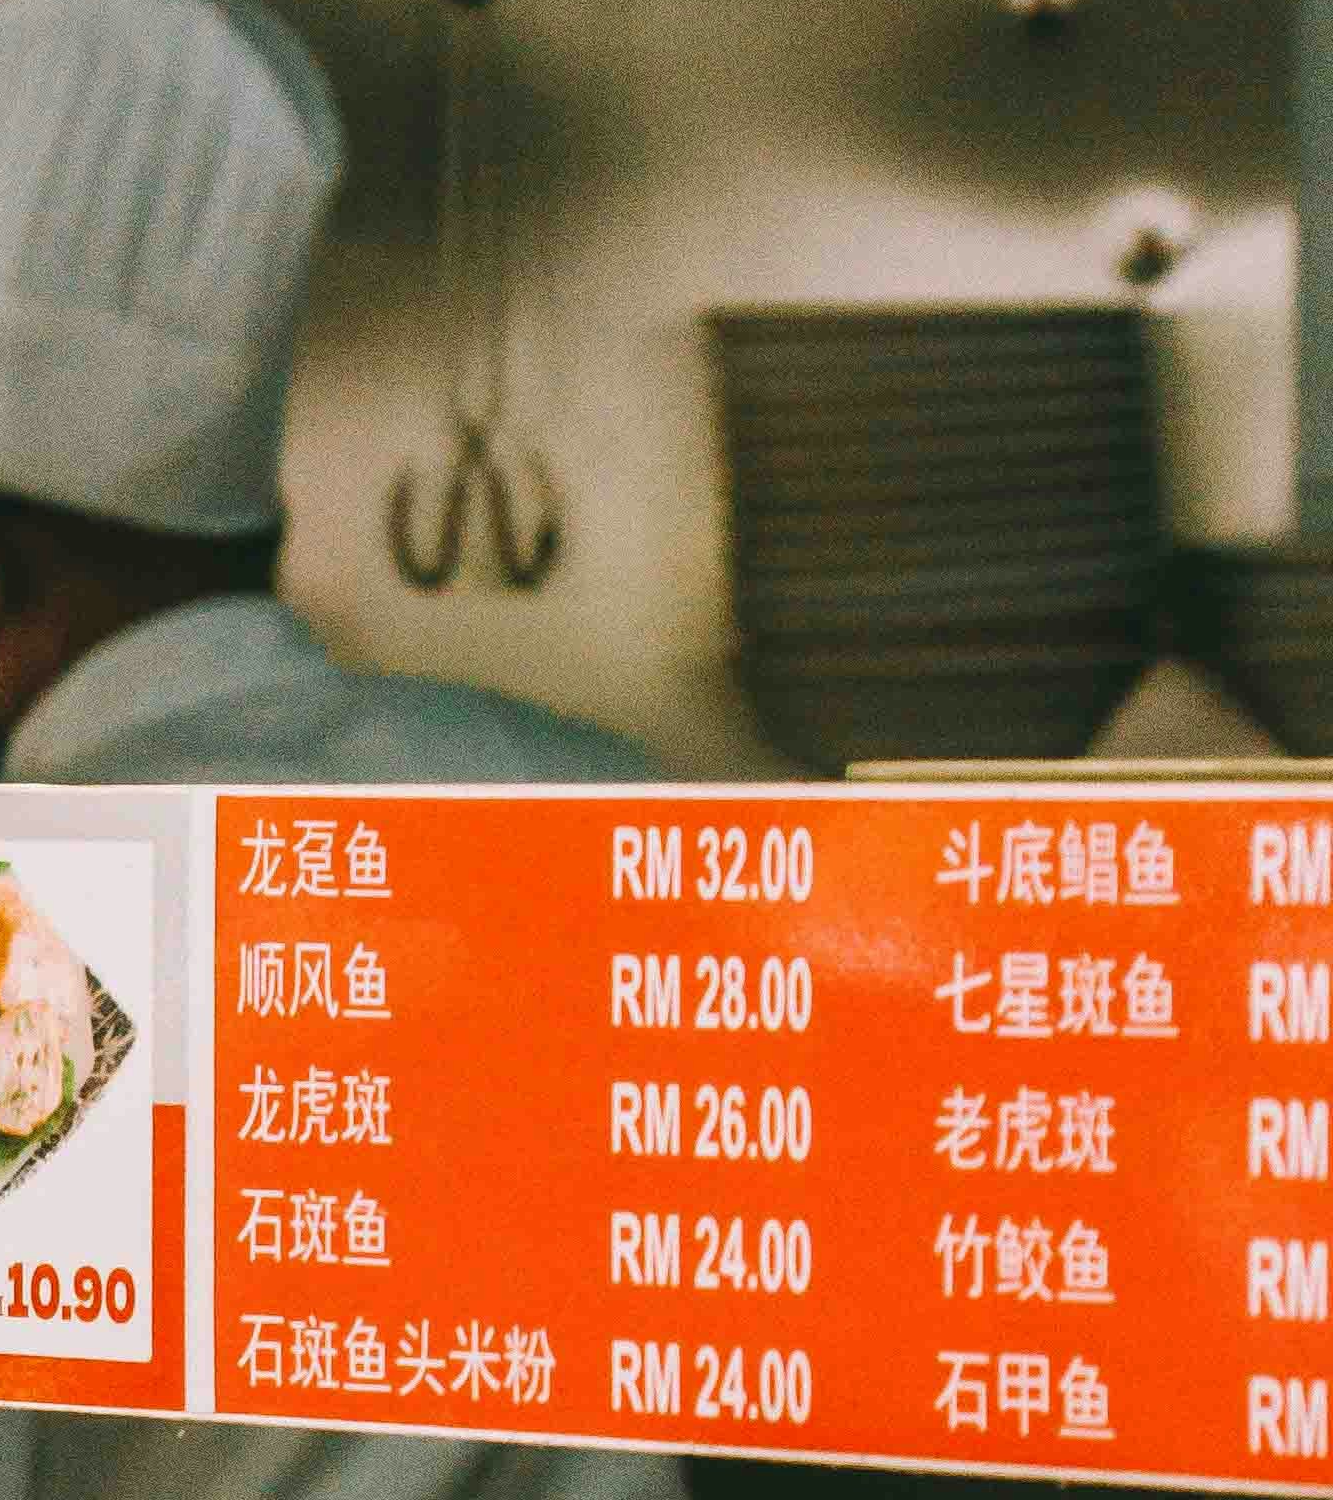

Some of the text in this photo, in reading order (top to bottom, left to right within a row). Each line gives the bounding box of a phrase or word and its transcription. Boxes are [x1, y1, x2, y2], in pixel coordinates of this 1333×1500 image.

[239, 819, 392, 898] 龙趸鱼
[613, 825, 814, 903] RM 32.00
[935, 819, 1181, 905] 斗底鲳鱼
[1249, 819, 1333, 906] RM
[237, 941, 392, 1019] 顺风鱼
[611, 953, 813, 1032] RM 28.00
[934, 951, 1180, 1038] 七星斑鱼
[1248, 960, 1331, 1043] RM
[238, 1064, 392, 1145] 龙虎斑
[611, 1081, 812, 1162] RM 26.00
[934, 1086, 1116, 1173] 老虎斑
[1247, 1097, 1330, 1180] RM
[237, 1188, 391, 1267] 石斑鱼
[611, 1211, 812, 1294] RM 24.00
[934, 1213, 1115, 1303] 竹鲛鱼
[7, 1261, 137, 1325] 10.90
[1247, 1237, 1329, 1321] RM
[237, 1314, 557, 1404] 石斑鱼头米粉
[611, 1339, 812, 1424] RM 24.00
[934, 1350, 1115, 1439] 石甲鱼
[1247, 1375, 1328, 1458] RM
